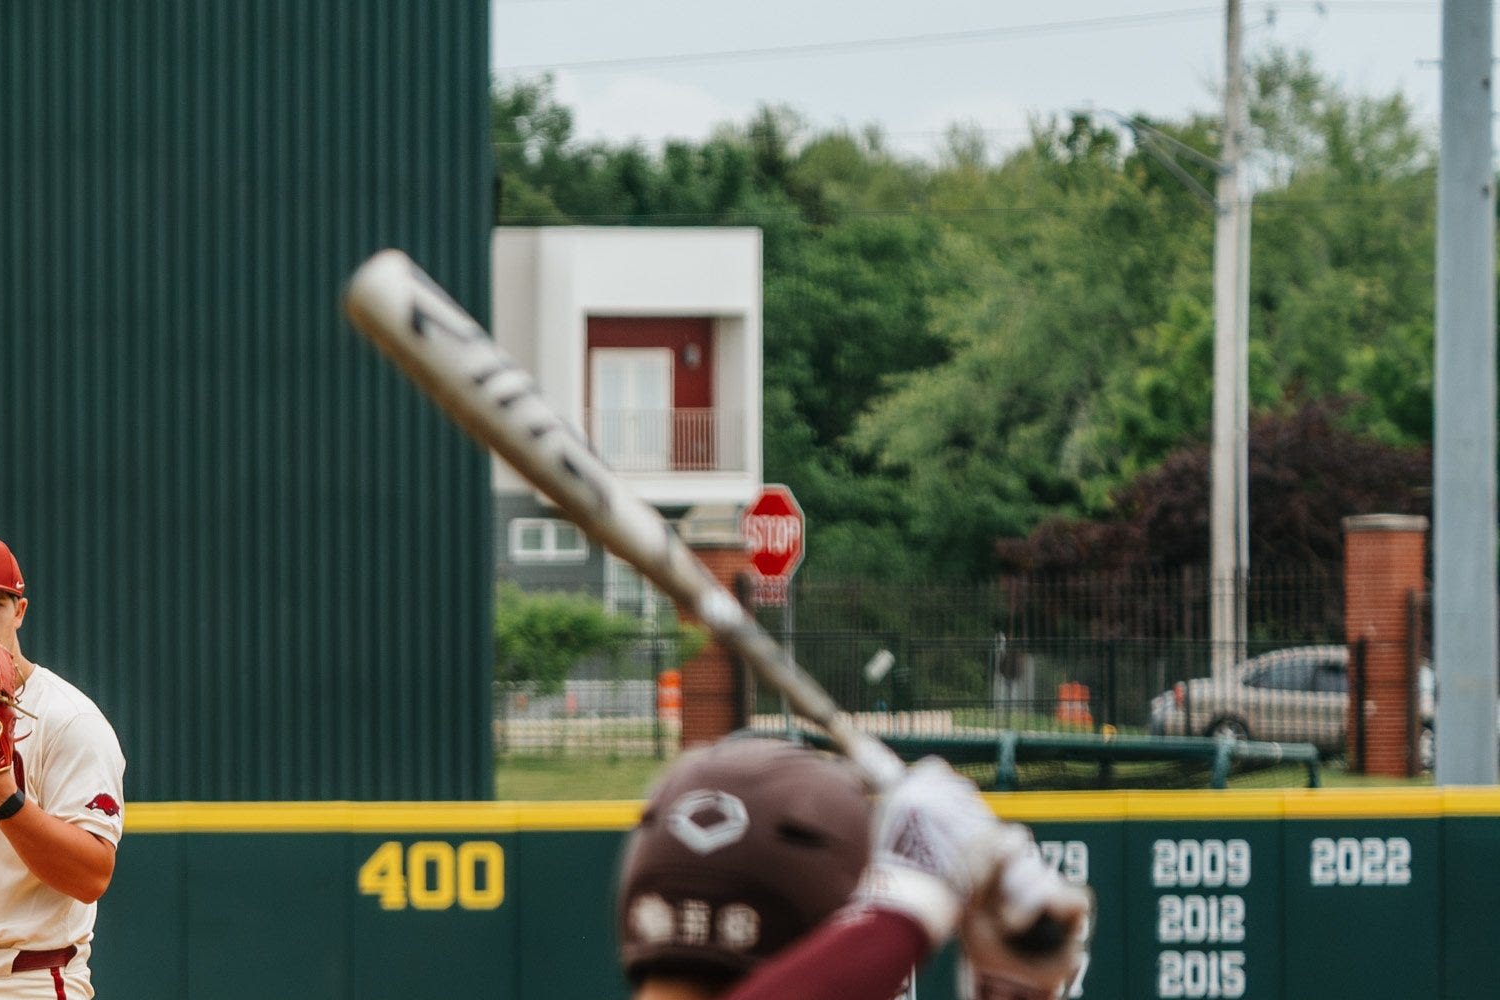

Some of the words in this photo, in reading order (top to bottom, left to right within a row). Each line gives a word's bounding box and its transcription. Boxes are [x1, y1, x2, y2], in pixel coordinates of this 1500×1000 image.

[743, 514, 800, 554] STOP
[358, 840, 505, 910] 400
[1152, 838, 1250, 888] 2009
[1310, 837, 1412, 886] 2022
[1157, 894, 1246, 944] 2012
[1157, 950, 1246, 999] 2015
